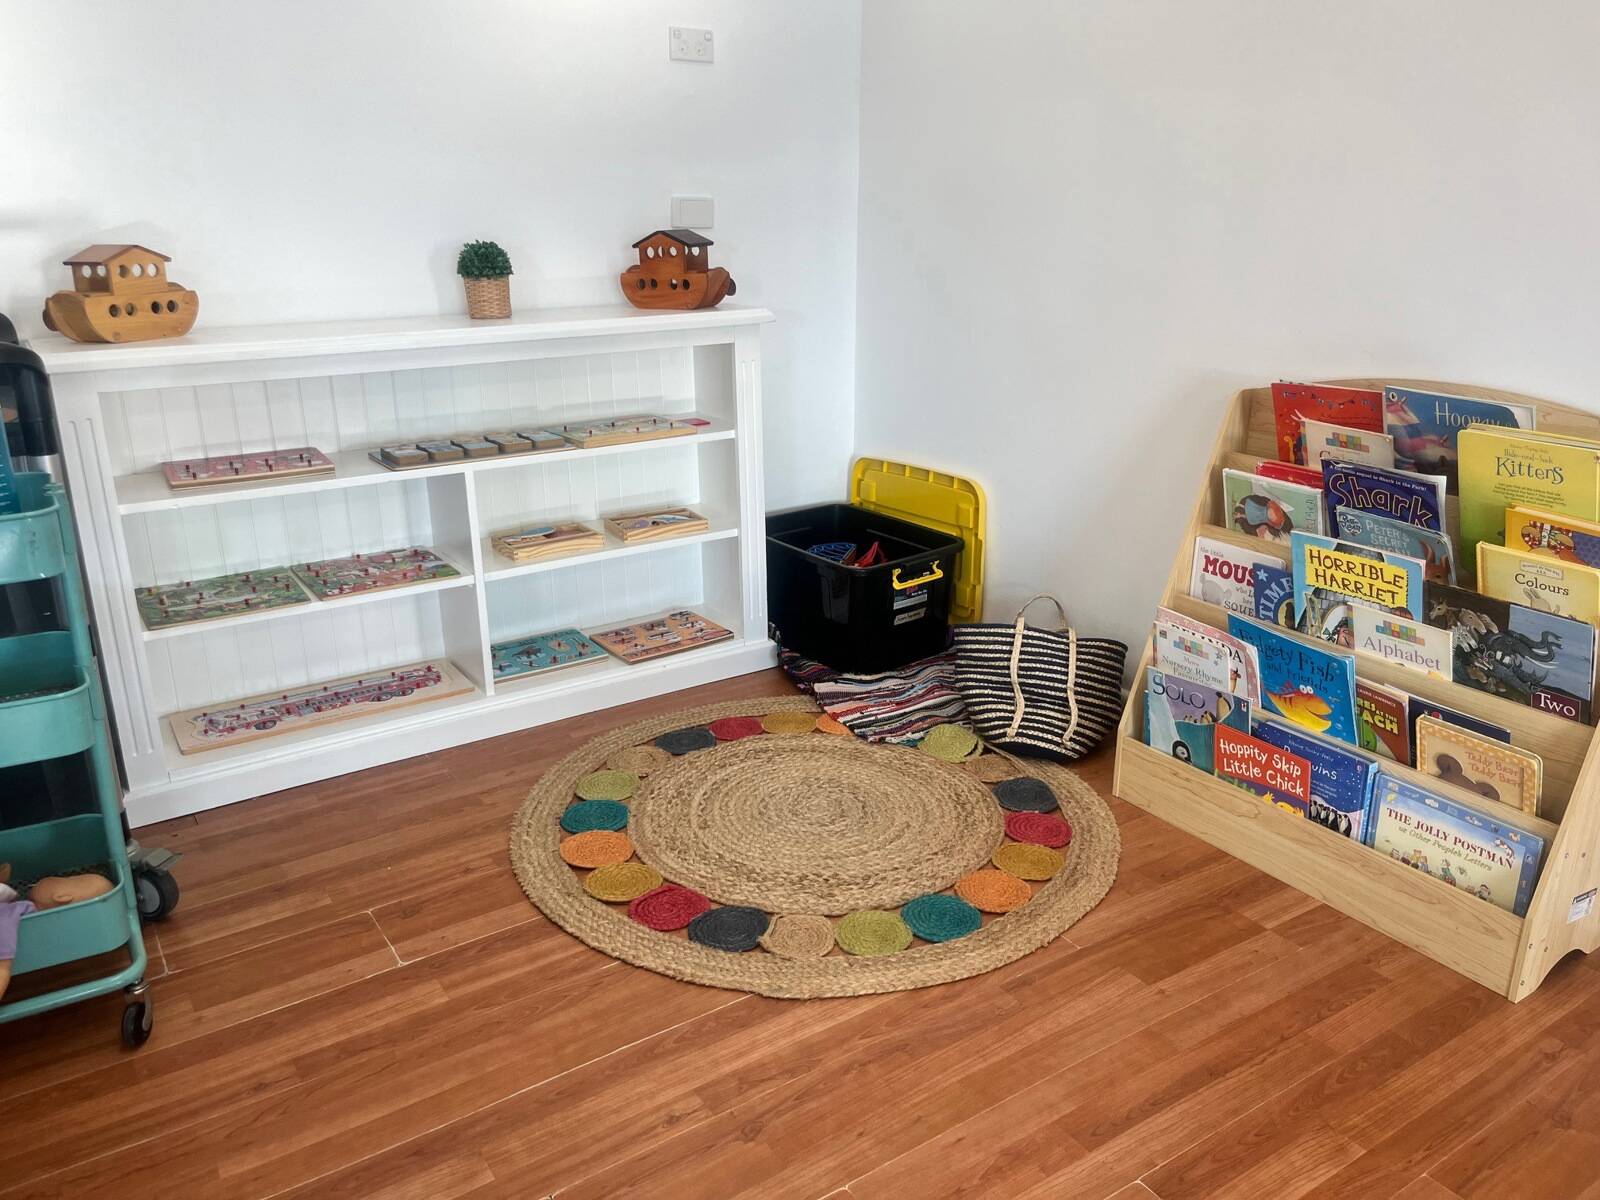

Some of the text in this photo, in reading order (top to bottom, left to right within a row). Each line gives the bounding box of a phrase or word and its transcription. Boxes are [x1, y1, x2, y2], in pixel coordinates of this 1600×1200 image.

[1329, 473, 1433, 530] Shark
[1308, 548, 1405, 589] HORRIBLE
[1314, 567, 1399, 605] HARRIET
[1514, 573, 1569, 596] Colours
[1363, 635, 1441, 671] Alphabet
[1152, 672, 1206, 709] SOLO
[1535, 691, 1576, 718] Two
[1219, 739, 1268, 765] Hoppity
[1272, 754, 1301, 778] Skip
[1223, 758, 1262, 778] Little
[1266, 770, 1304, 797] Chick
[1386, 807, 1514, 870] THE JOLLY POSTMAN
